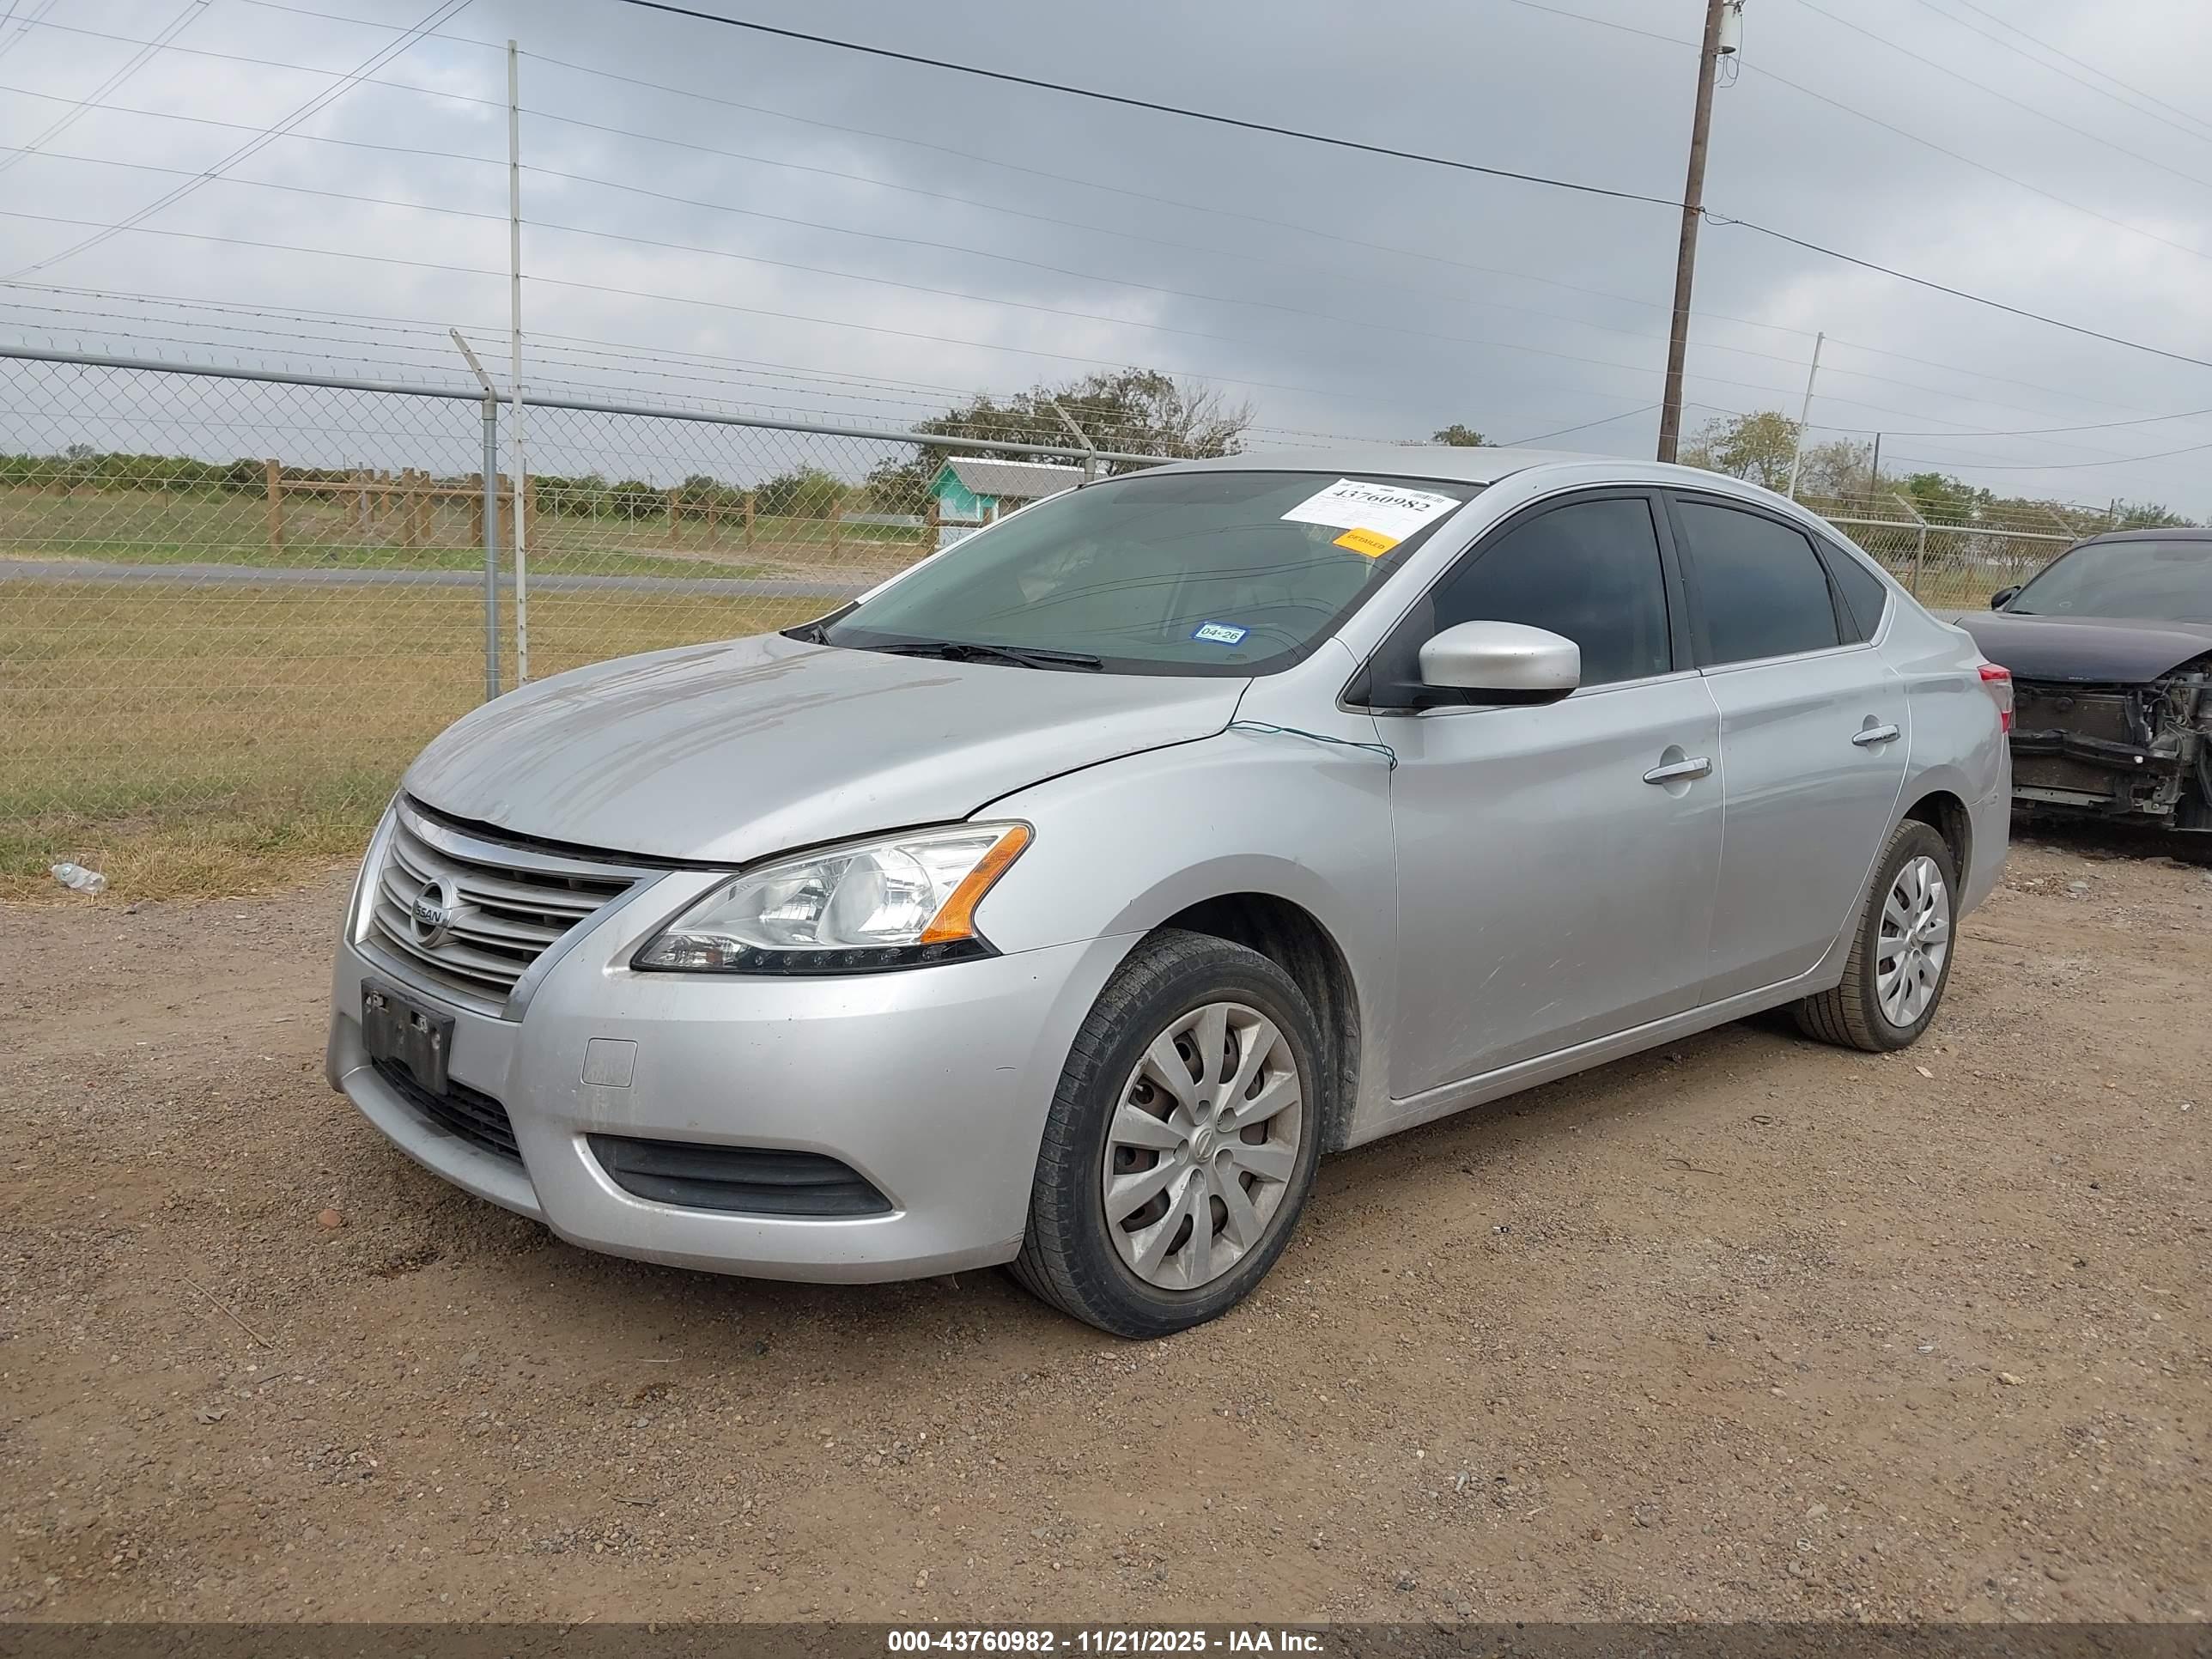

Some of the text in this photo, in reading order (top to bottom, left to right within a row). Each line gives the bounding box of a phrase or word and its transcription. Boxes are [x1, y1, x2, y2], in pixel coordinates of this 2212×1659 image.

[1333, 489, 1431, 513] 43760982
[1346, 533, 1386, 550] DETAILED
[415, 904, 442, 922] SSAN
